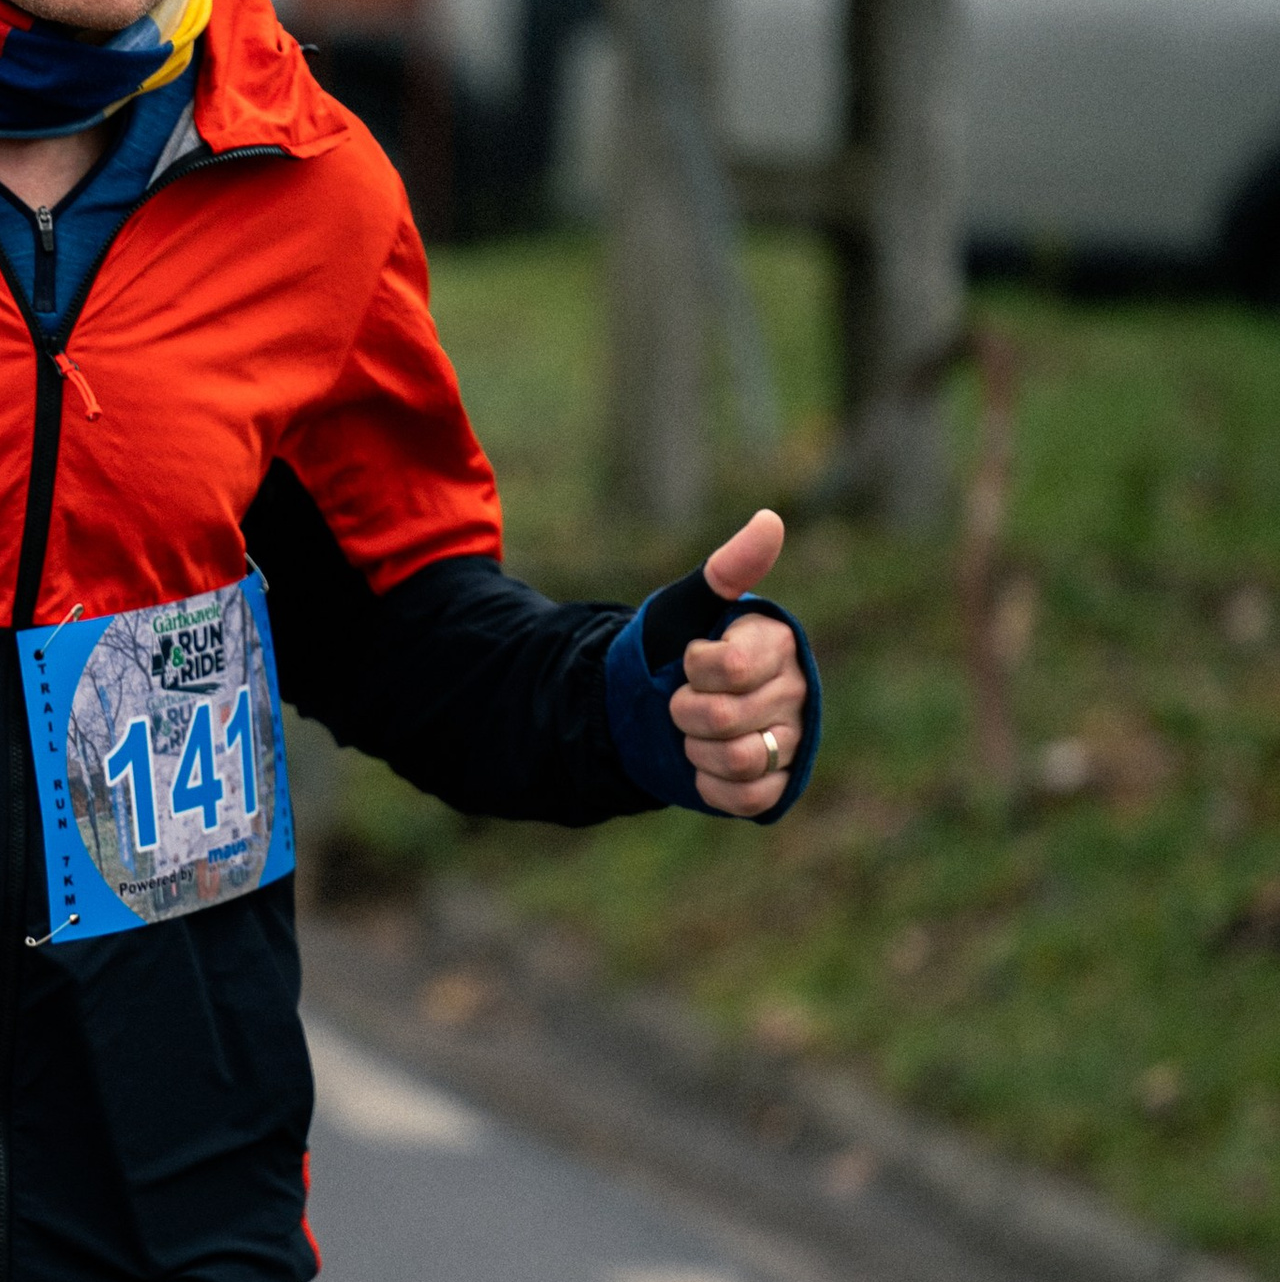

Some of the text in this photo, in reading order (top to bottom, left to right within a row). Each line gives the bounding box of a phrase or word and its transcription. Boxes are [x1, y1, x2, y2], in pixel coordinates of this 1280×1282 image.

[178, 621, 224, 655] RUN
[181, 649, 226, 684] RIDE
[36, 662, 77, 906] TRAIL RUN 7KM
[105, 685, 259, 852] 141
[119, 869, 177, 898] Powered
[179, 865, 195, 883] by
